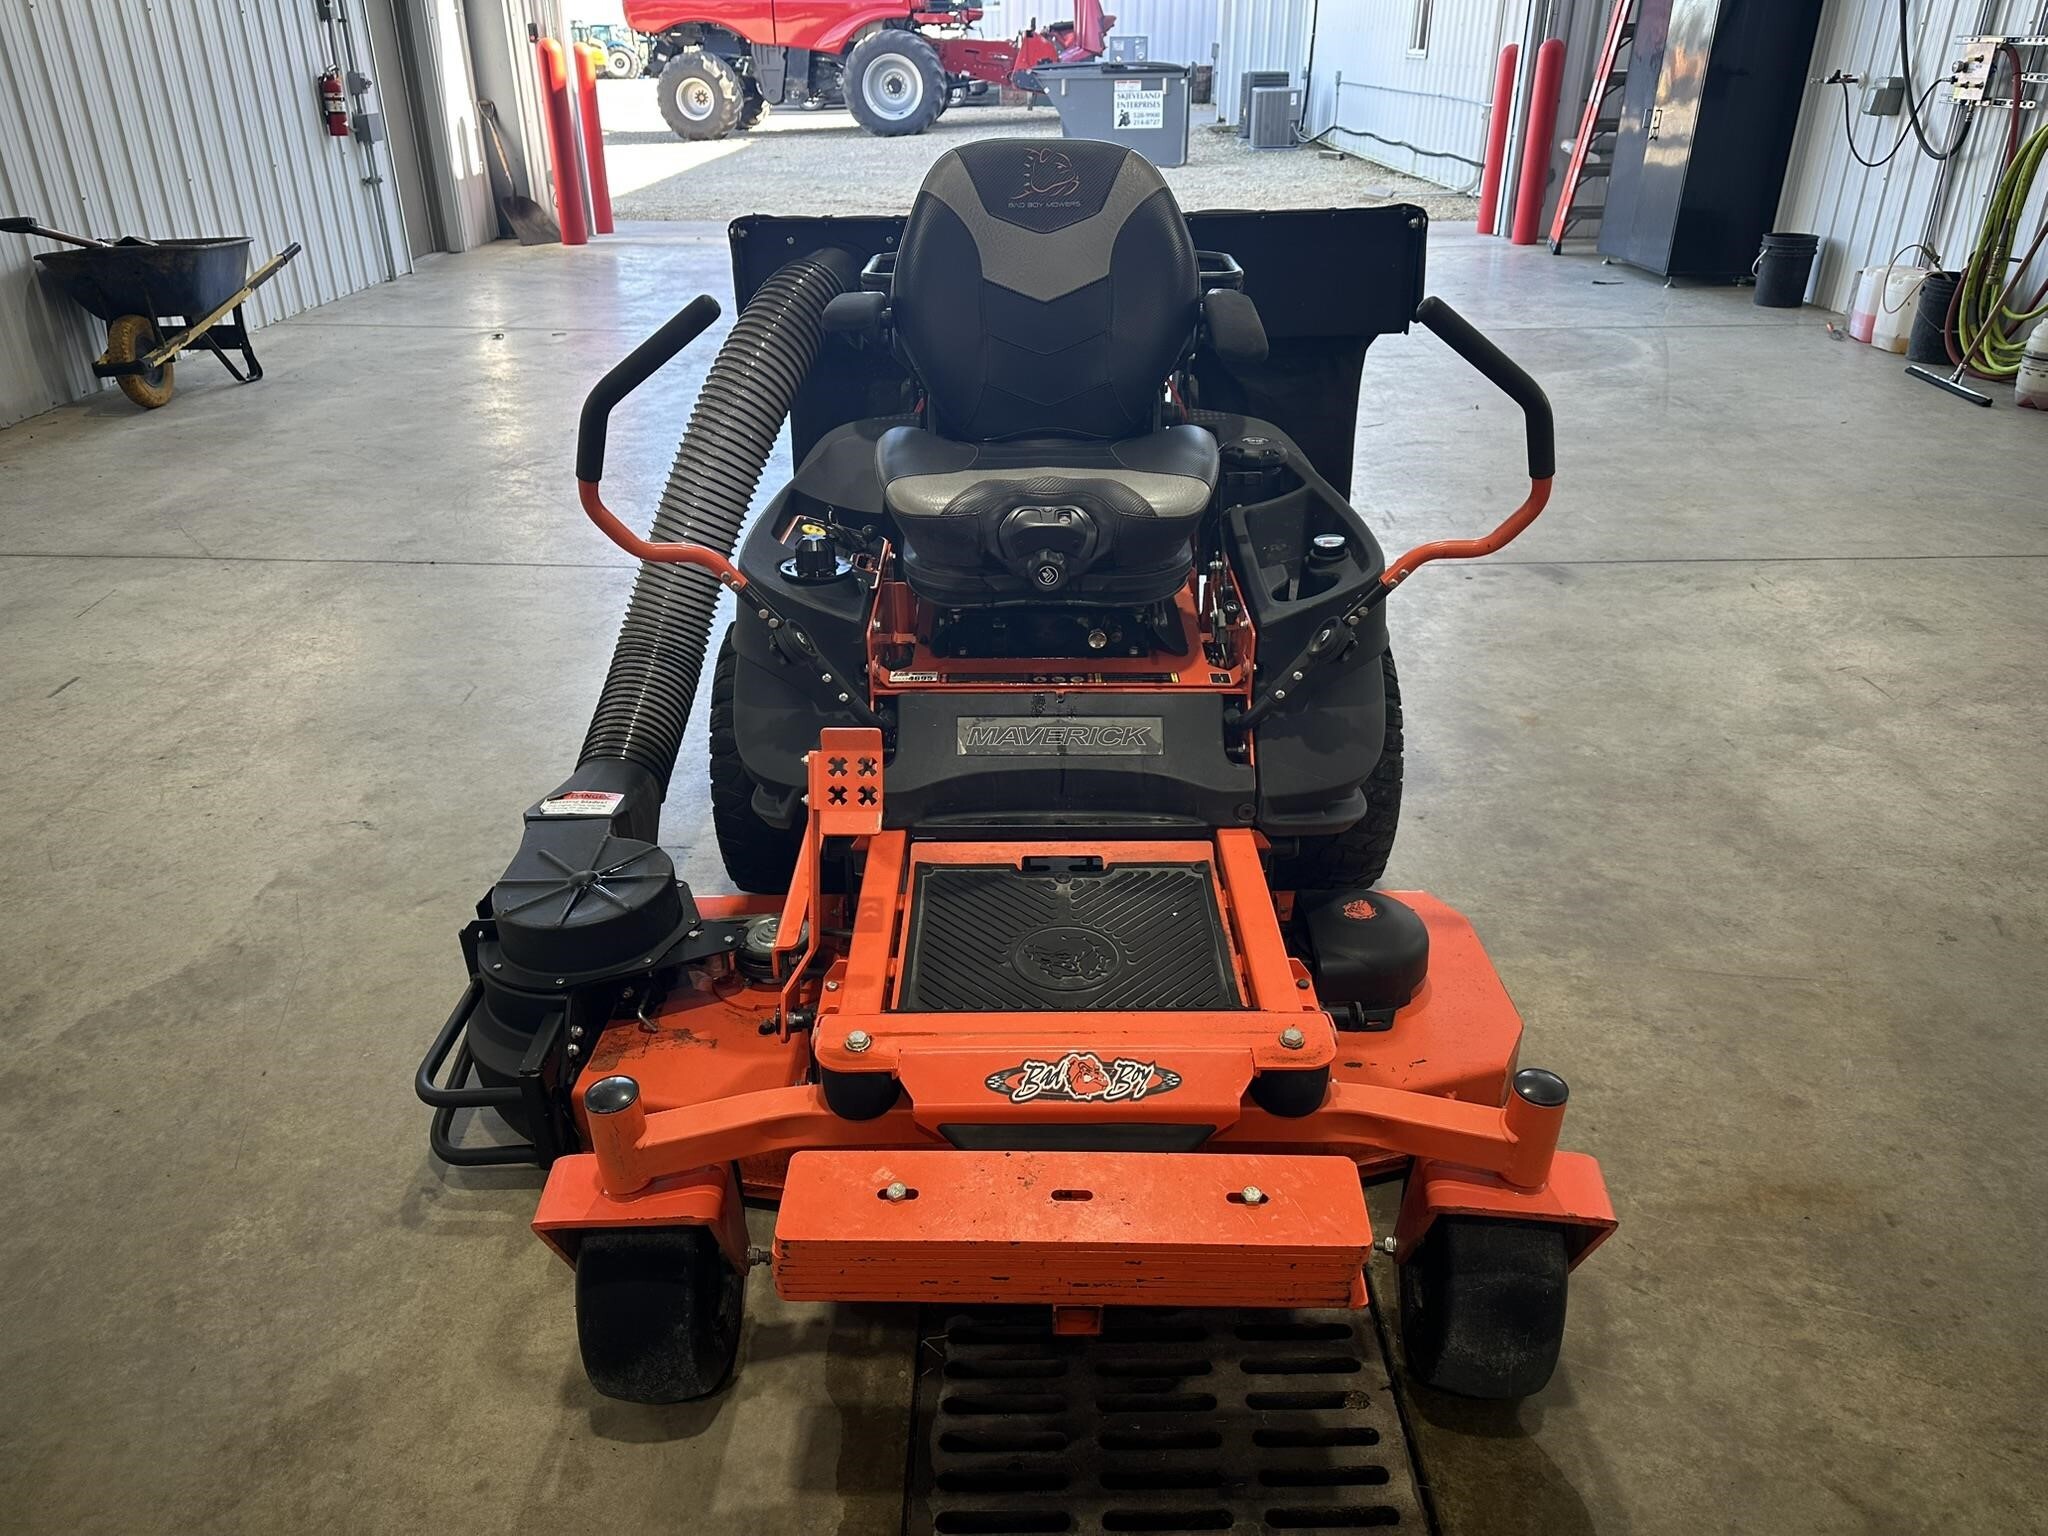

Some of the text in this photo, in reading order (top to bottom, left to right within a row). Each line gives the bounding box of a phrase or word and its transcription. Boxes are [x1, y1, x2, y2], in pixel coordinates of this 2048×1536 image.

[967, 726, 1151, 746] MAVERICK
[1012, 1057, 1156, 1100] Bad Boy
